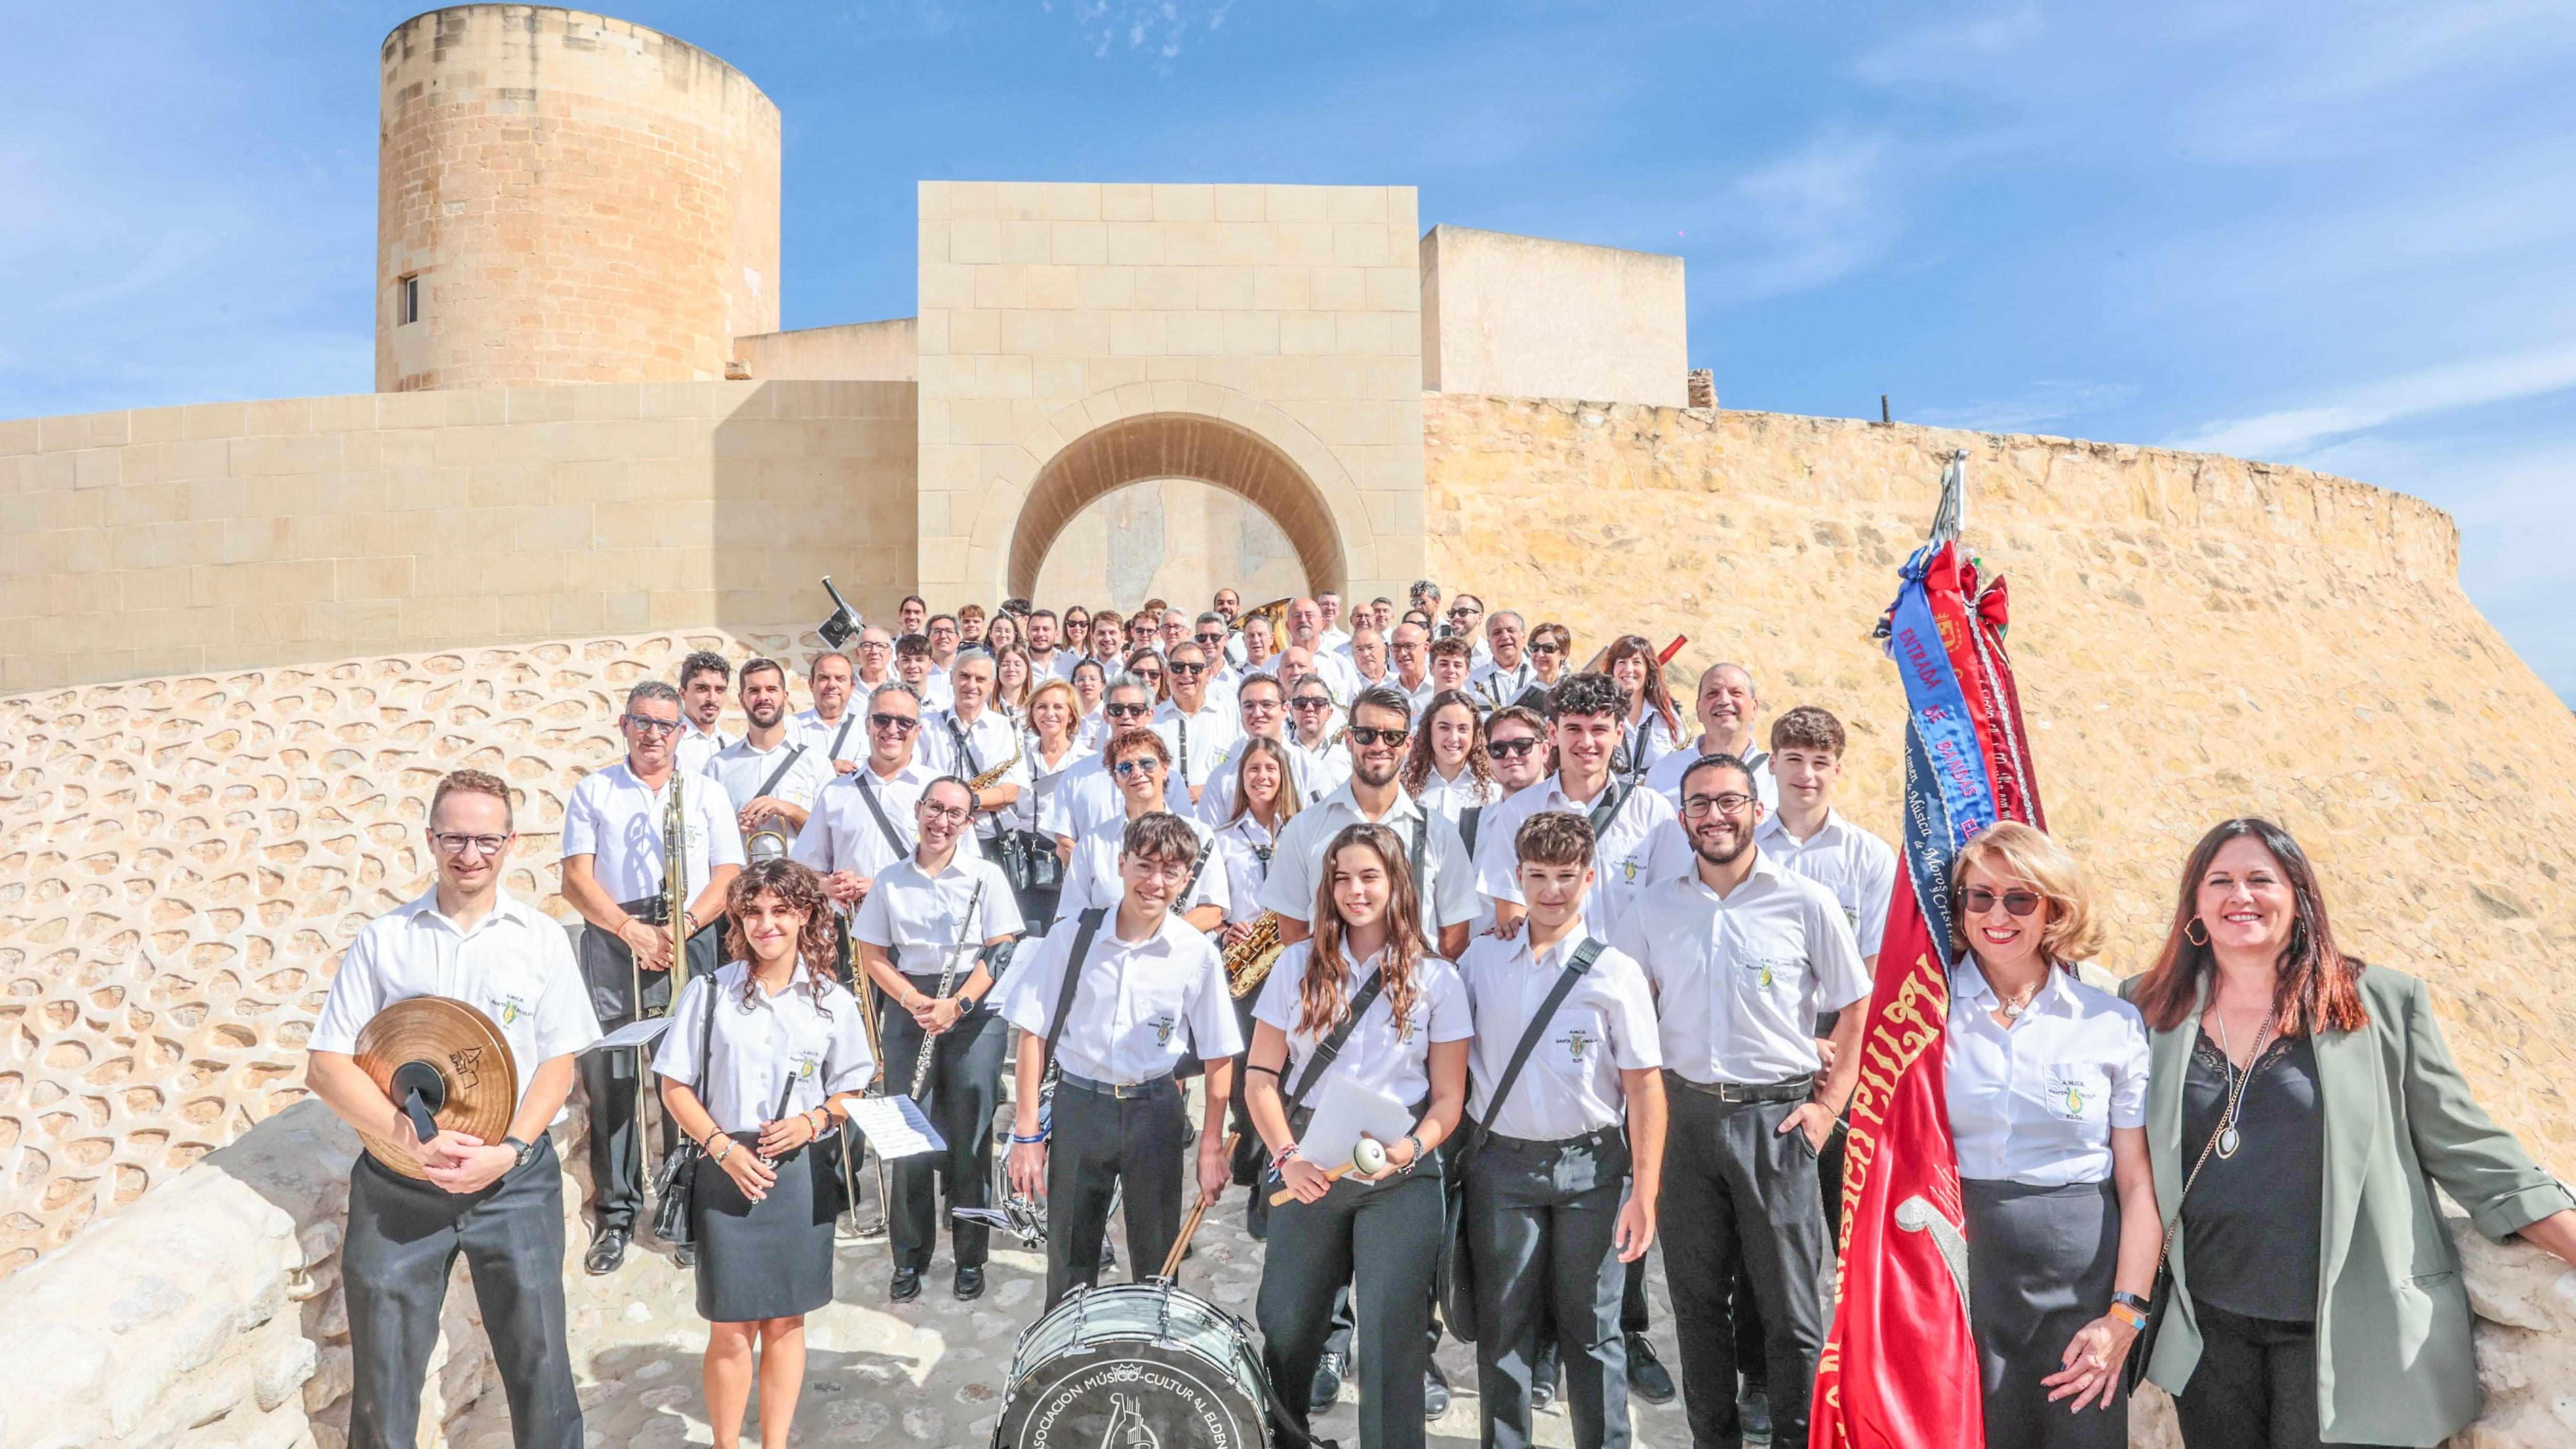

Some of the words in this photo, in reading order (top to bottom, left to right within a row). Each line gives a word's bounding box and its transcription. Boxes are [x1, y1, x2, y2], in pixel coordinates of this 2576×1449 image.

[1899, 628, 1943, 691] ENTRADA
[1923, 704, 1947, 724] DE
[1936, 740, 1977, 797] BANDAS
[1908, 791, 1933, 837] Música
[1913, 840, 1924, 850] de
[1922, 847, 1947, 893] Moros
